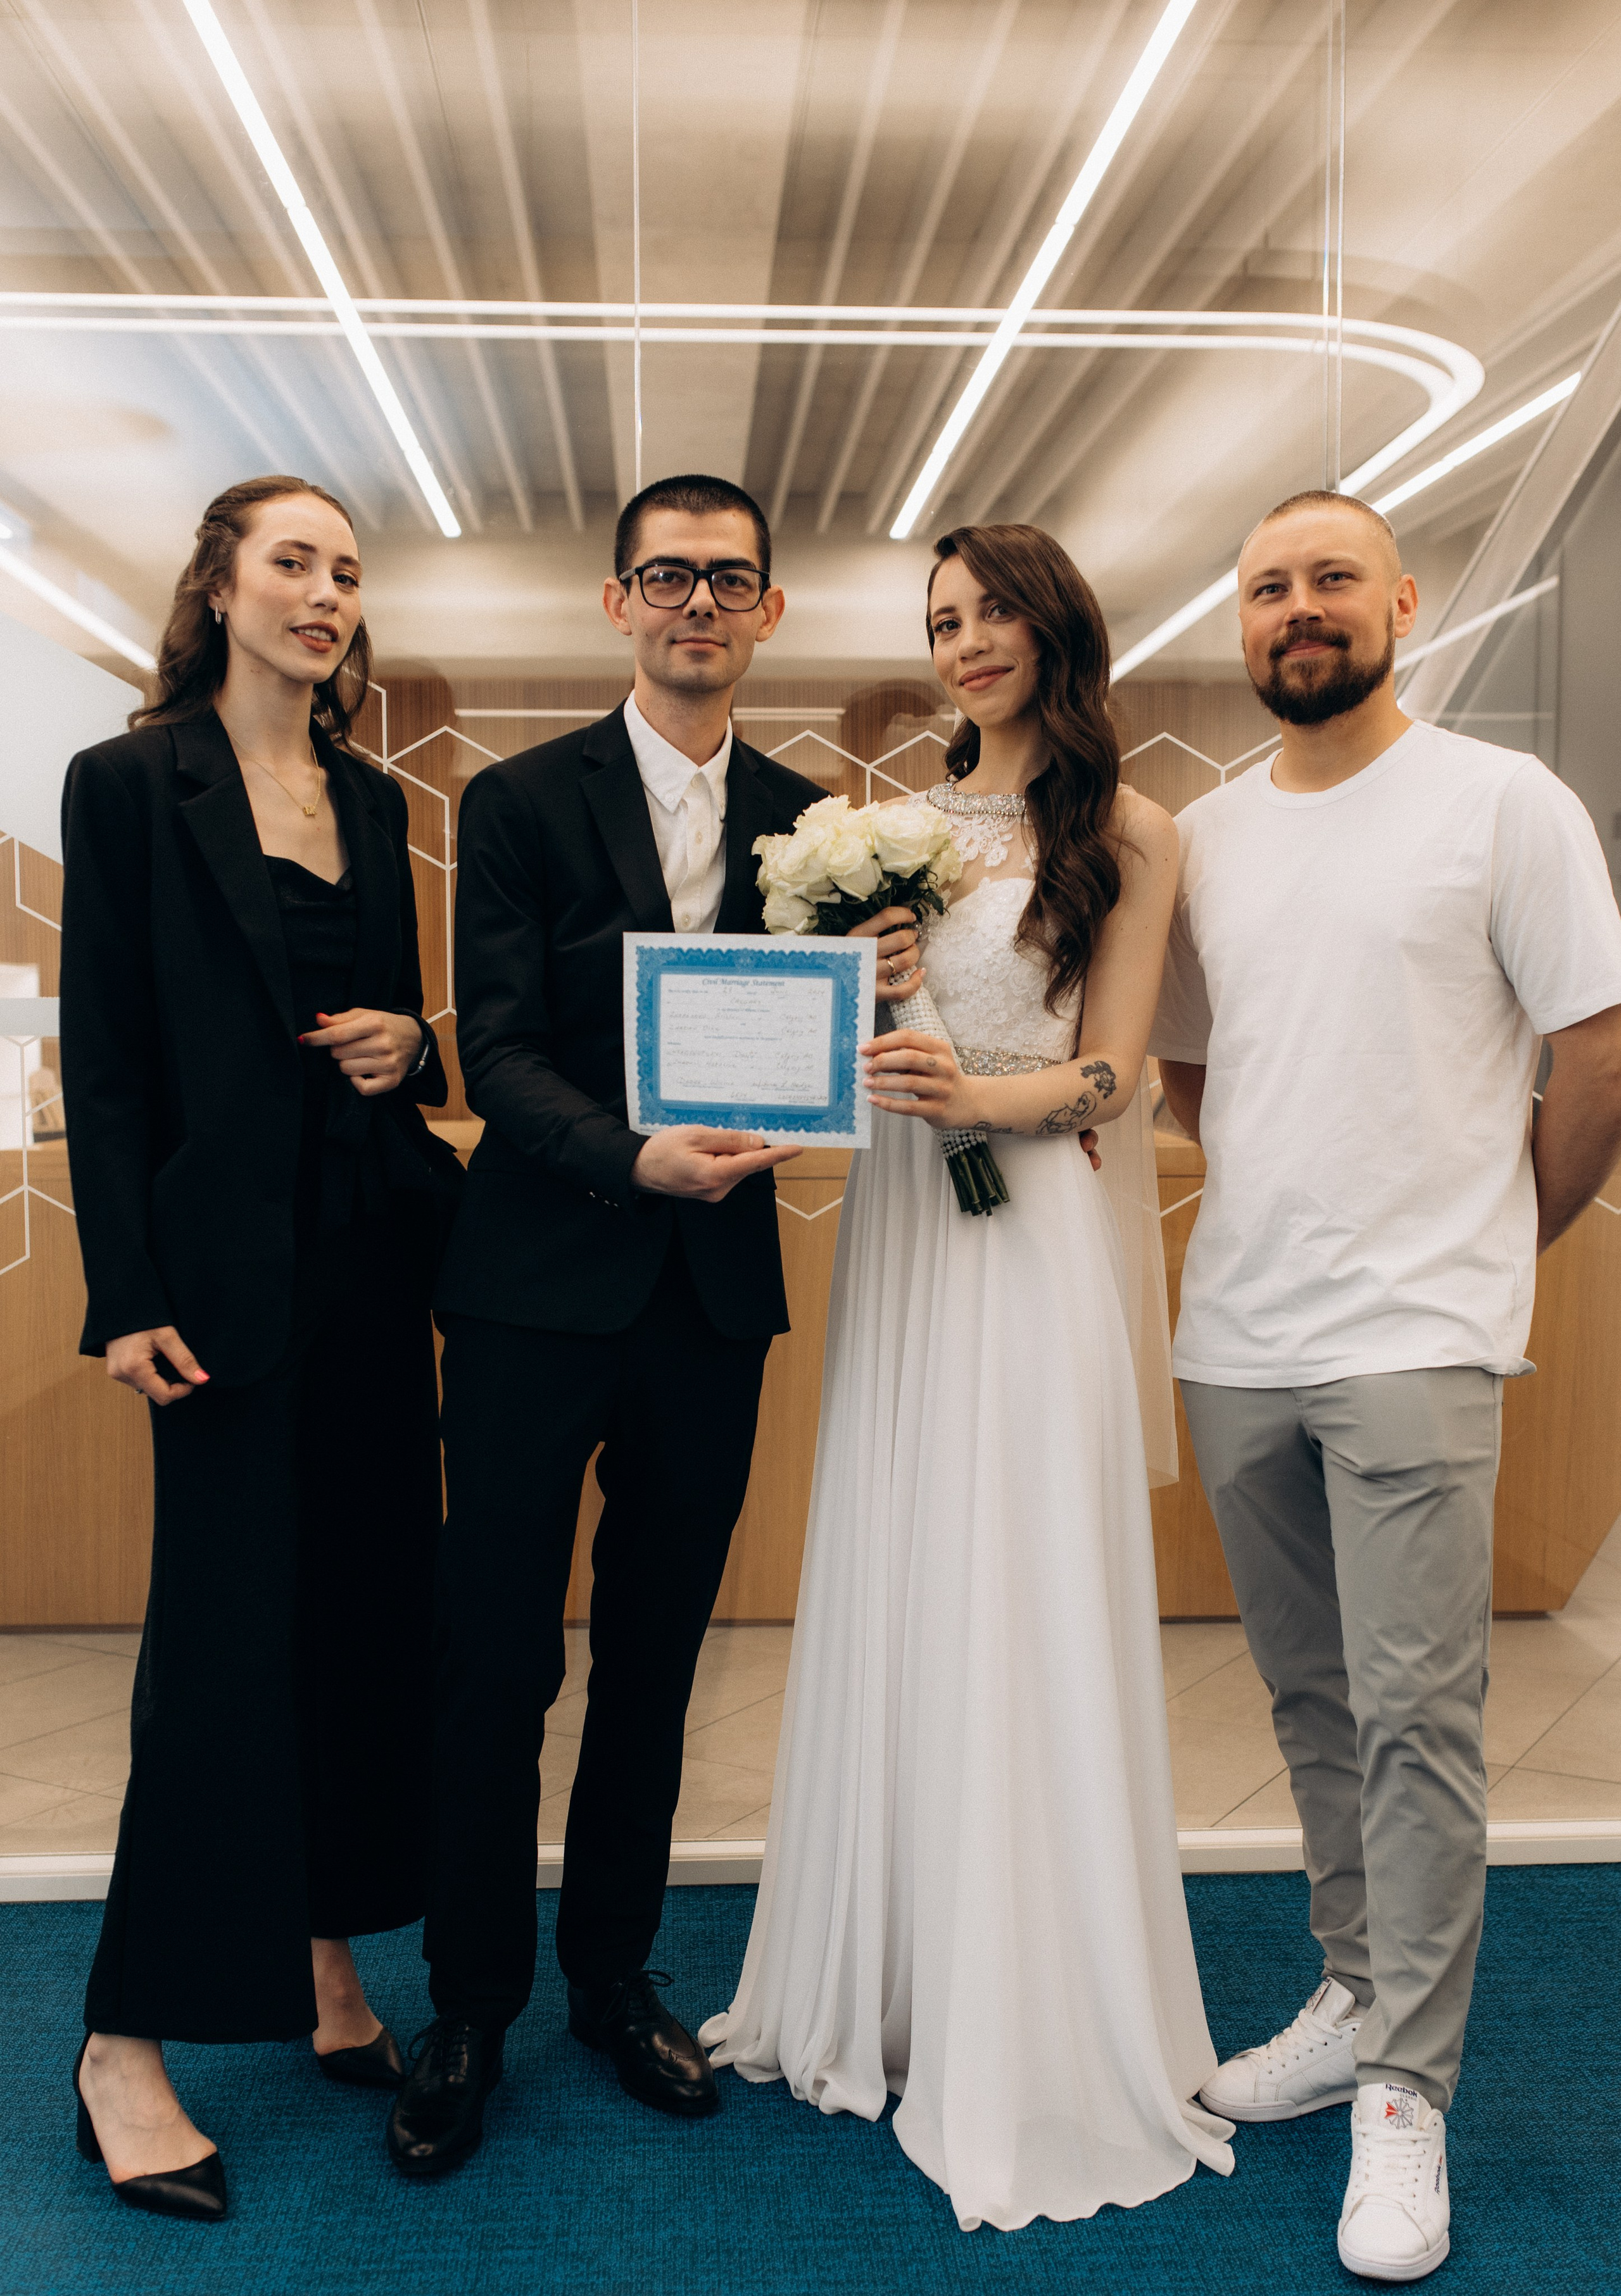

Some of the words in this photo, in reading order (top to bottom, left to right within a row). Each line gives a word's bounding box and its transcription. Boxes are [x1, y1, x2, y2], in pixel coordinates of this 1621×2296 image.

[702, 978, 718, 986] Civil
[721, 979, 750, 988] Marriage
[752, 979, 785, 988] Statement
[1385, 2083, 1418, 2097] Reebok
